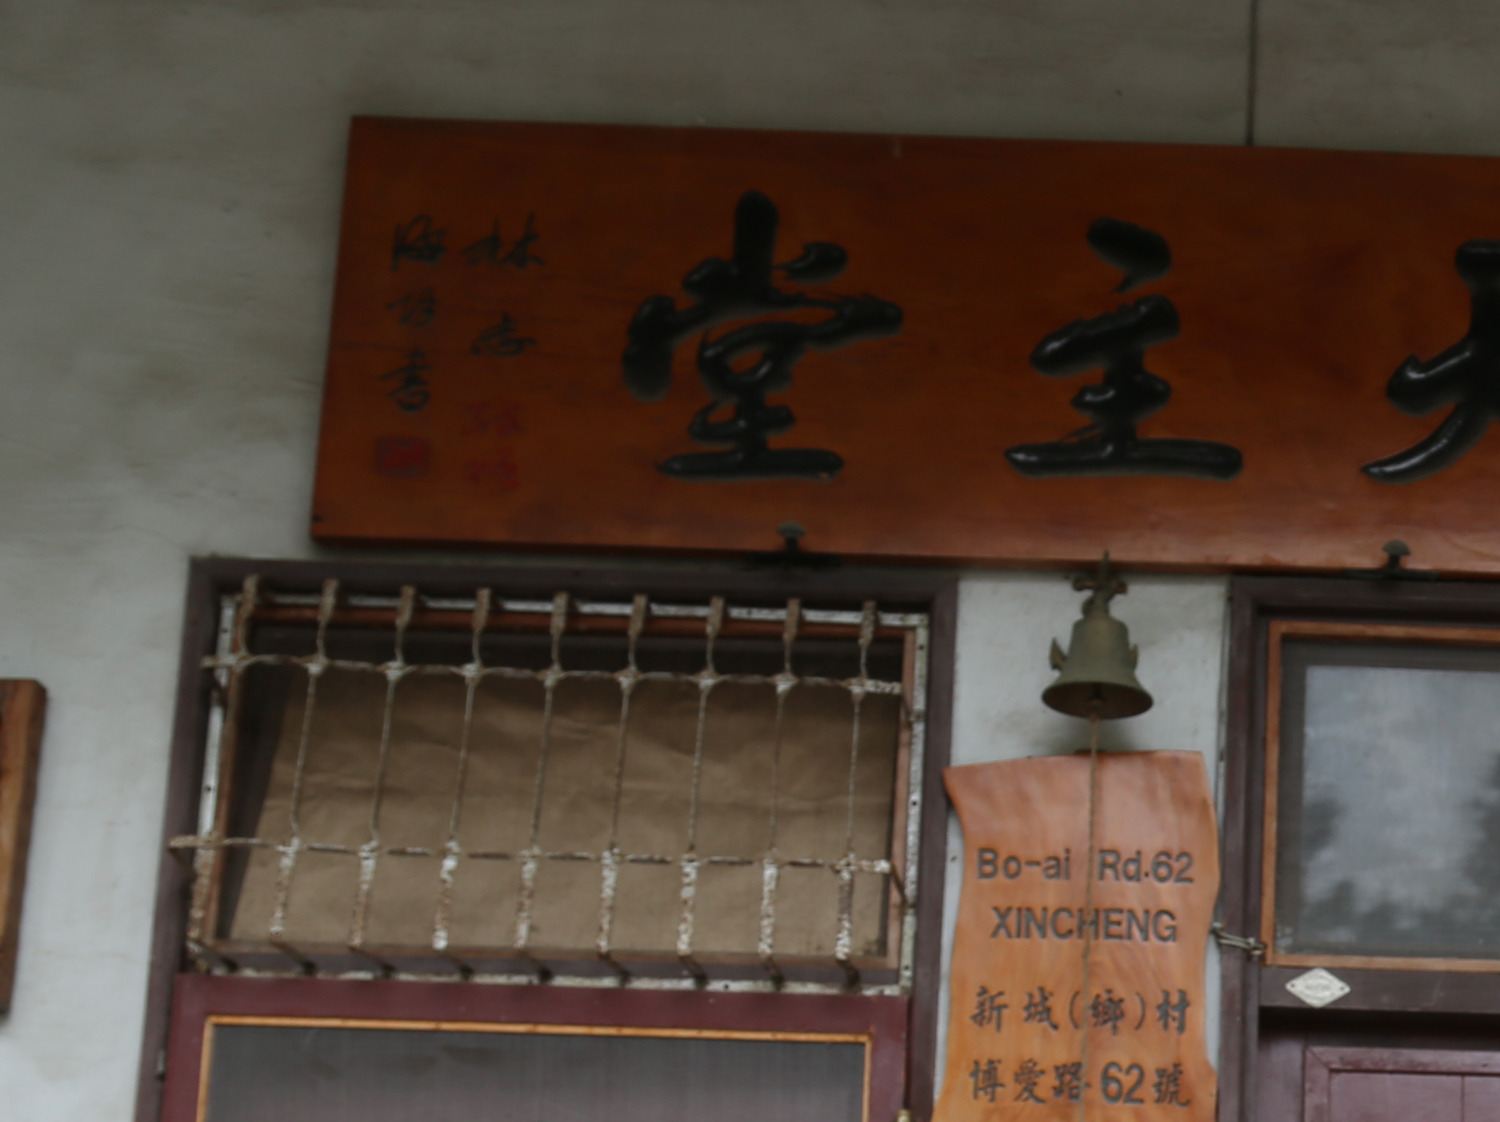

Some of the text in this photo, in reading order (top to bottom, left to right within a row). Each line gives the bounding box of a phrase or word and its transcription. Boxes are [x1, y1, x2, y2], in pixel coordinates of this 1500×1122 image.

[976, 848, 1195, 884] Bo-ai Rd.62
[989, 905, 1178, 943] XINCHENG
[968, 1058, 1191, 1108] 博愛路62號
